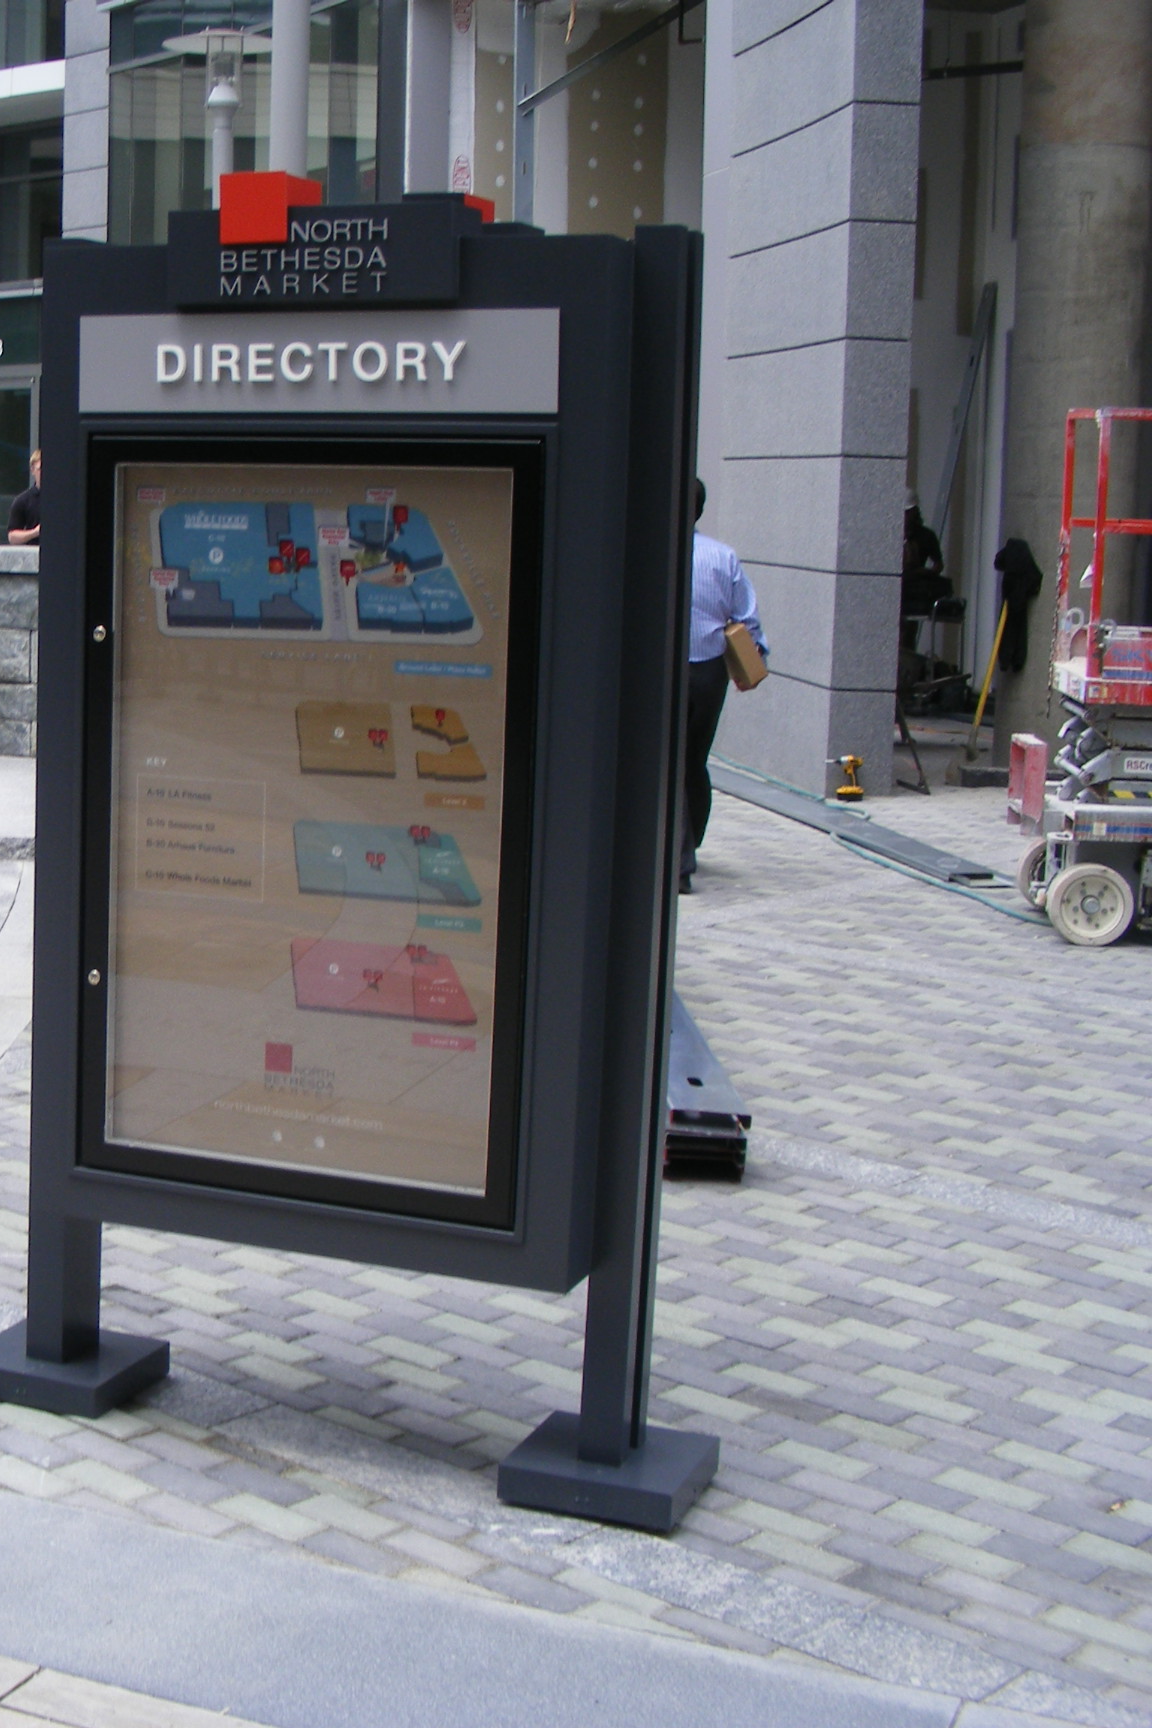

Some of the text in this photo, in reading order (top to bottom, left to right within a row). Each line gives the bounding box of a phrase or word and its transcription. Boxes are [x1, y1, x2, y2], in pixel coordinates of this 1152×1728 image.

[290, 218, 388, 243] NORTH
[220, 246, 387, 273] BETHESDA
[220, 272, 387, 296] MARKET
[156, 340, 467, 383] DIRECTORY
[146, 757, 167, 767] KEY
